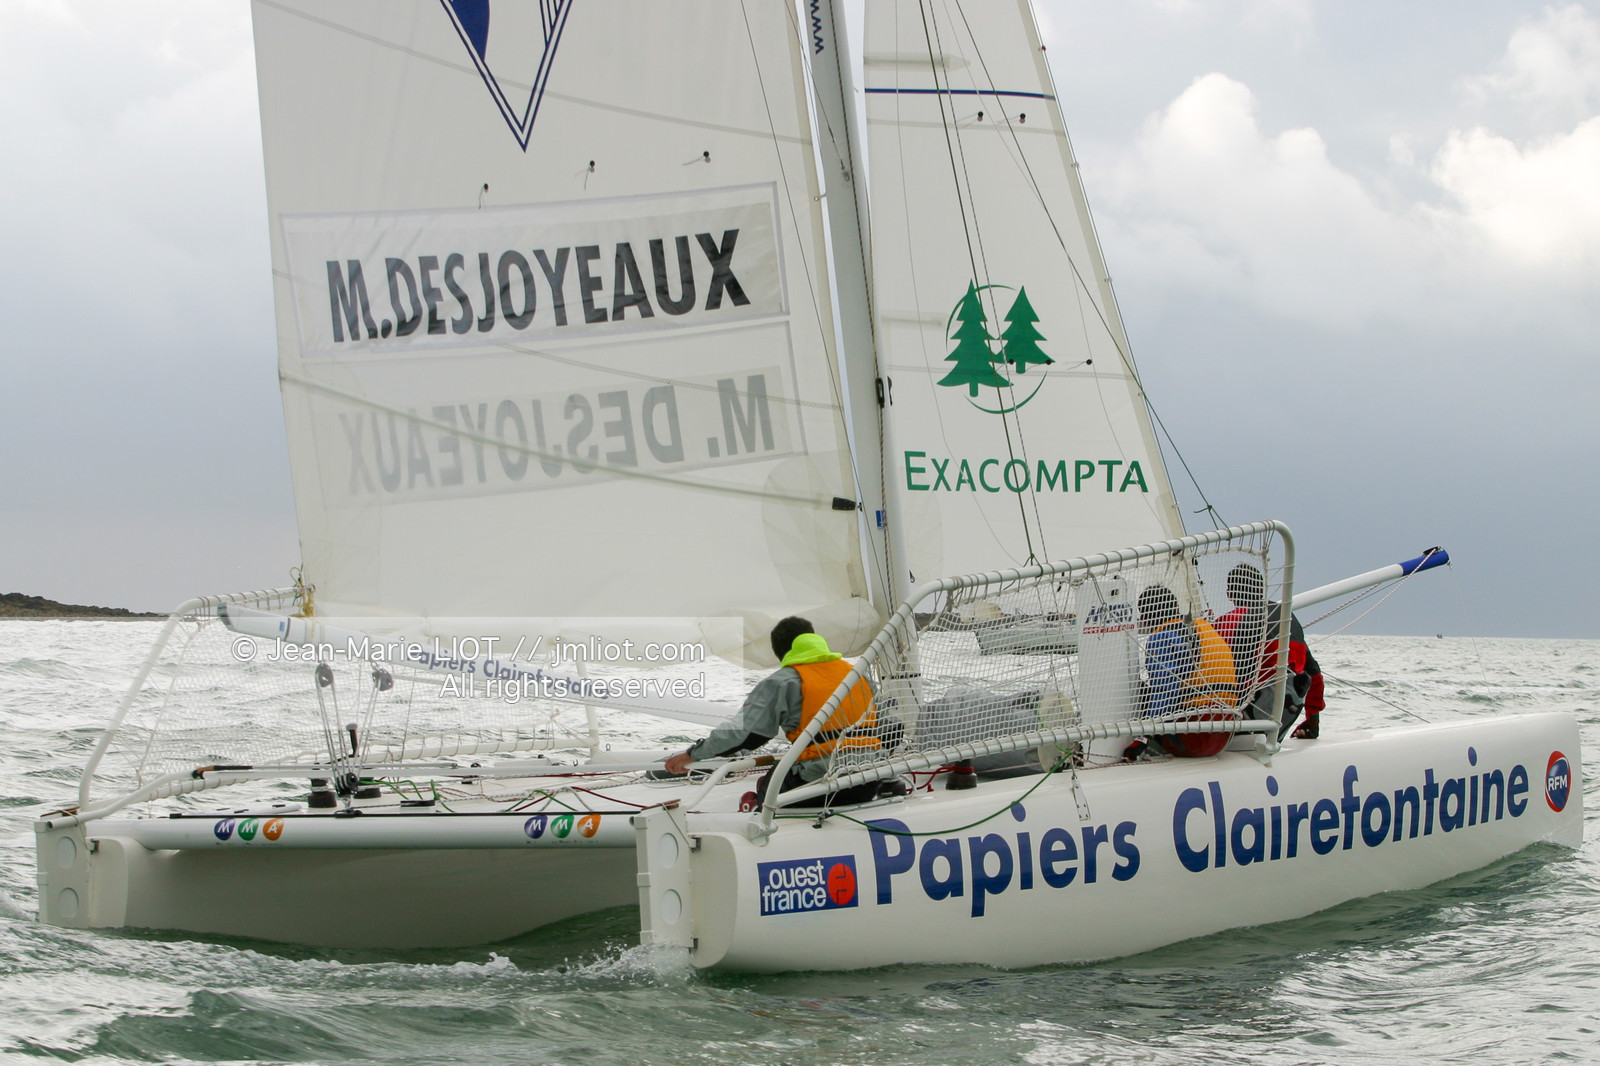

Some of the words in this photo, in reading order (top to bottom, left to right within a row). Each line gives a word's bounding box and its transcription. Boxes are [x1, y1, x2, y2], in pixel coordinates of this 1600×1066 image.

[326, 229, 751, 343] M.DESJOYEAUX
[1548, 774, 1568, 791] RFM
[865, 800, 1141, 918] Papiers
[1172, 745, 1530, 873] Clairefontaine
[769, 860, 826, 889] ouest
[762, 885, 827, 912] france
